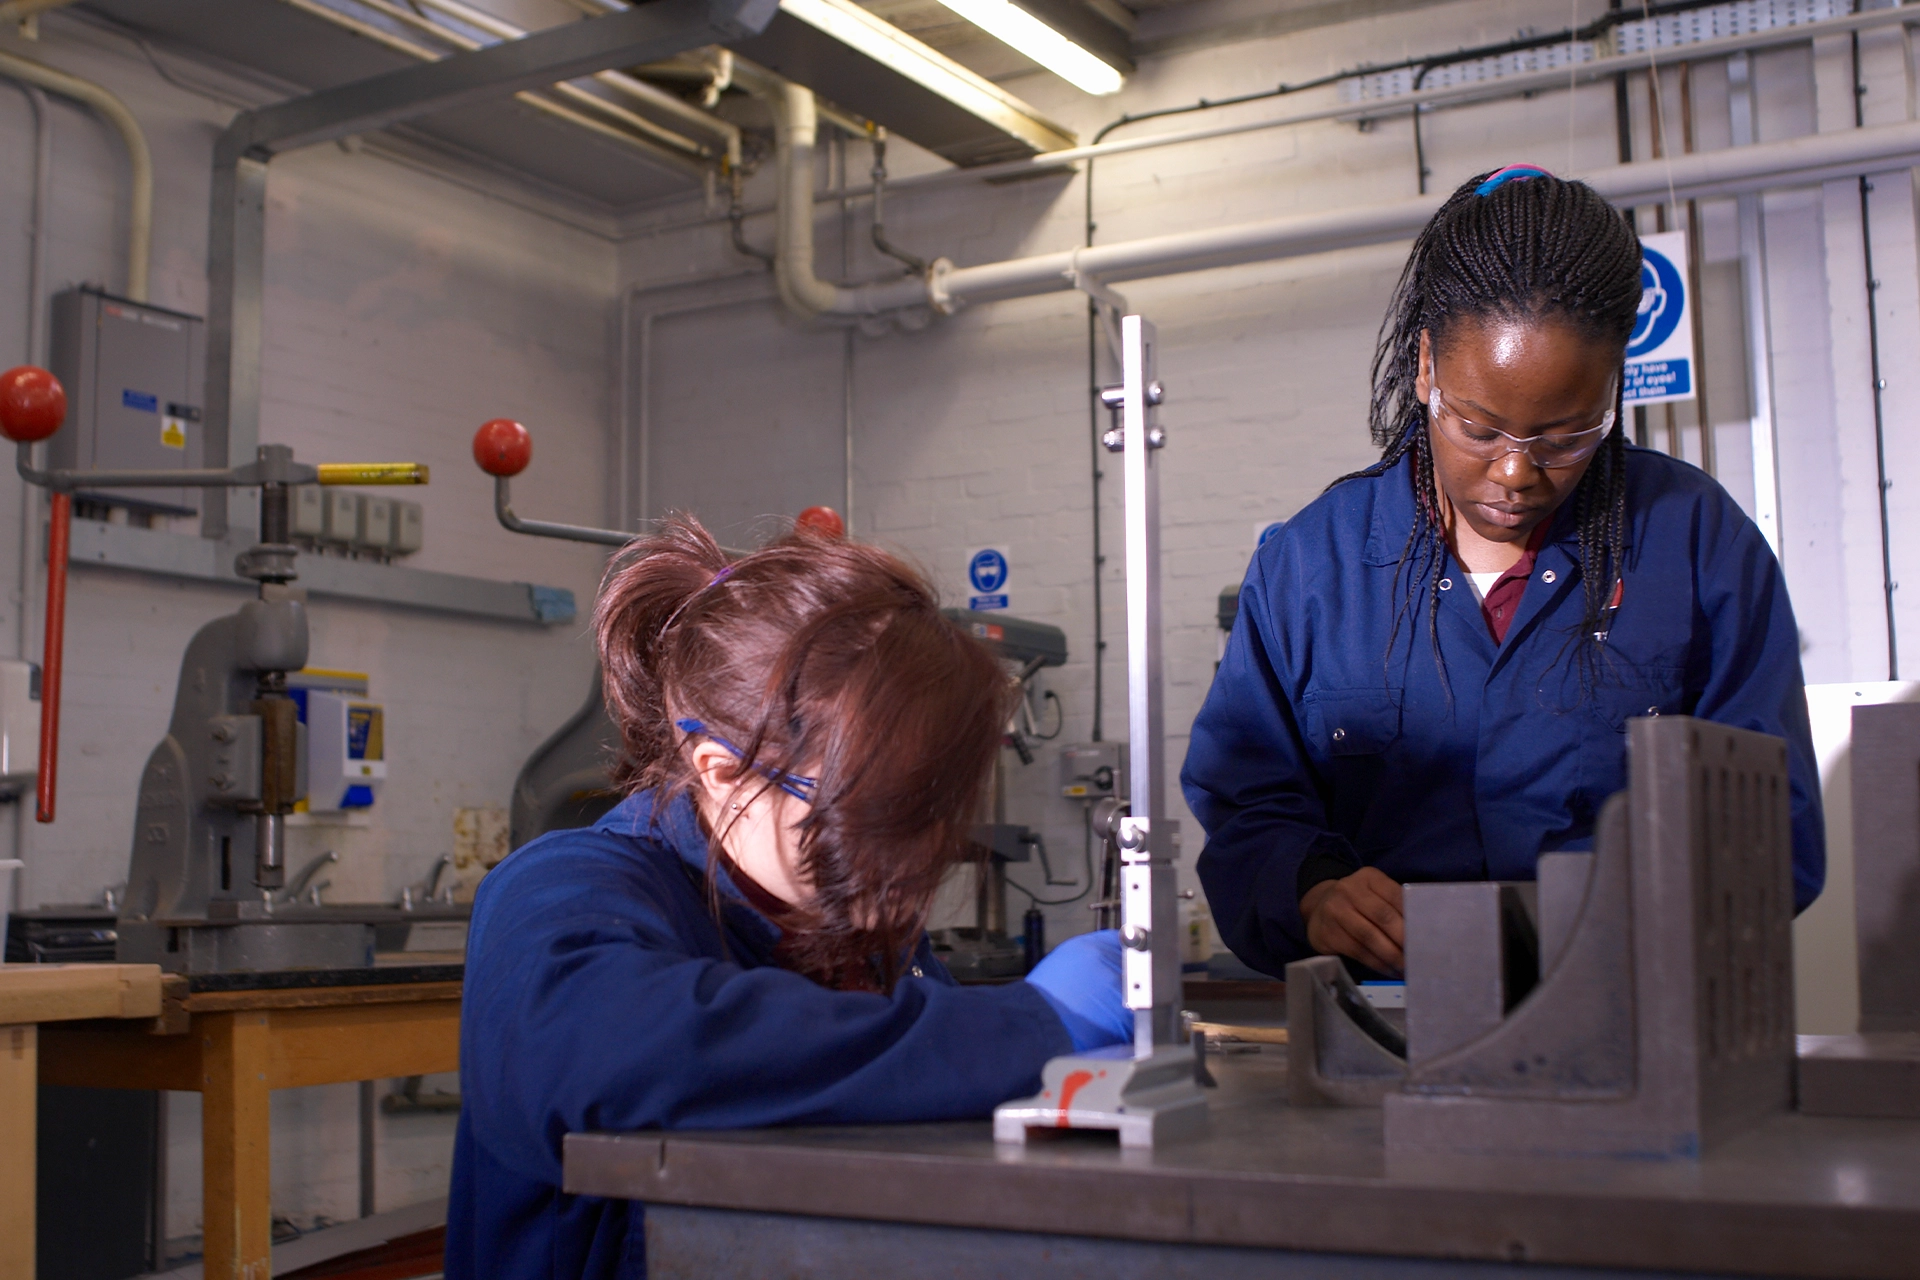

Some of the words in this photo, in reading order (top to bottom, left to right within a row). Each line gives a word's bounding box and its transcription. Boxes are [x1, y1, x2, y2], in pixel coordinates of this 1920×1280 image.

[1642, 362, 1668, 374] have
[1633, 375, 1645, 387] of
[1646, 370, 1676, 386] eyes!
[1639, 385, 1667, 397] them
